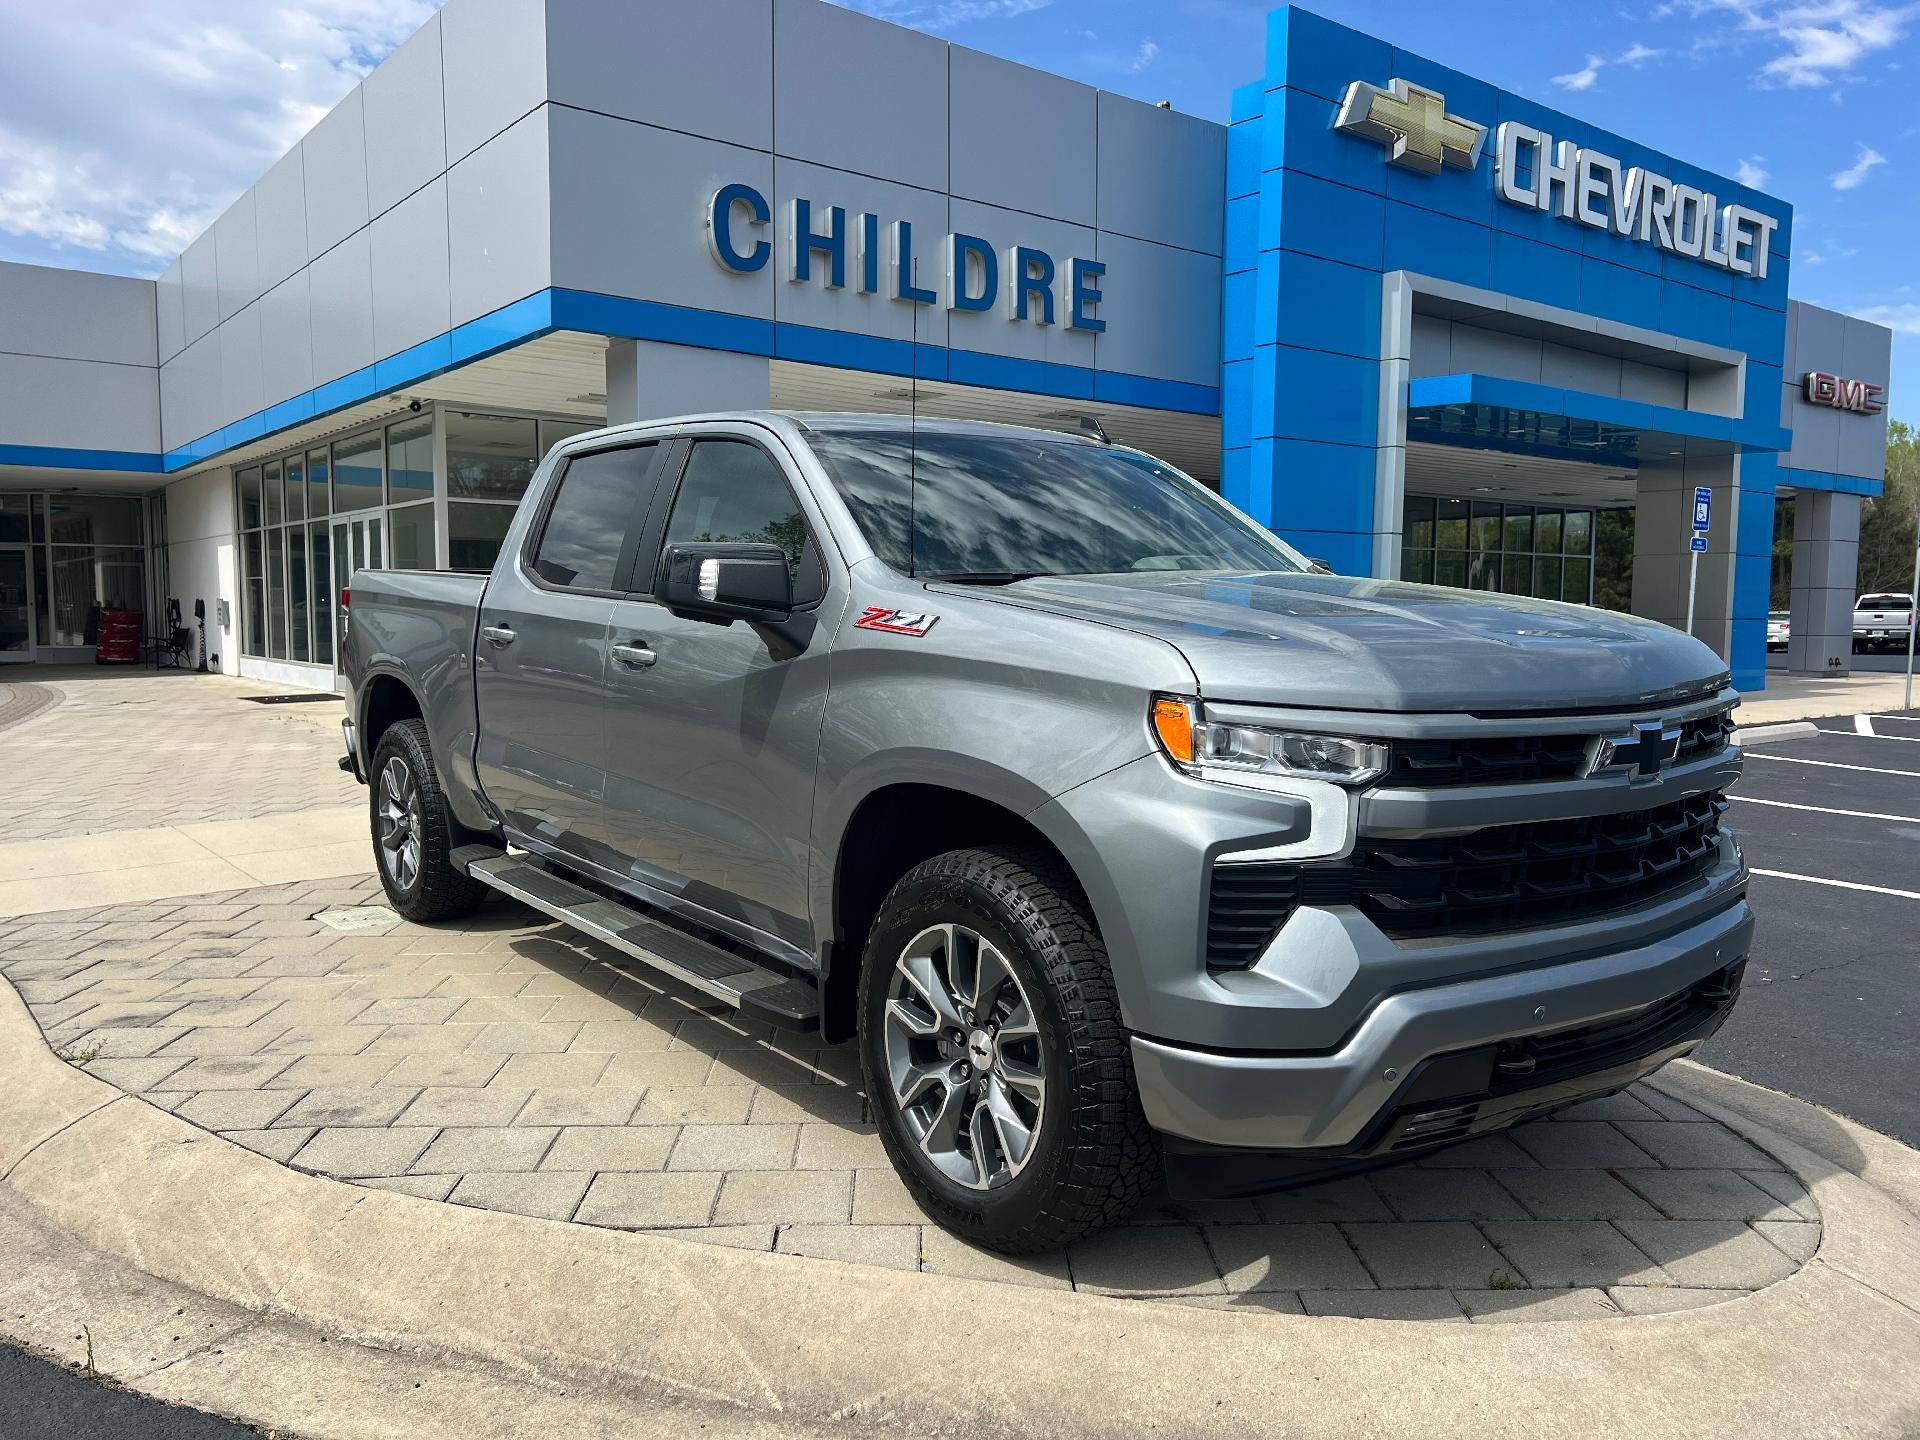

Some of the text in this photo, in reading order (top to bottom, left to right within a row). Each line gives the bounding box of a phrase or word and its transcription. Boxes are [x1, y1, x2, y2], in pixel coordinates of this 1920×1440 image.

[1495, 121, 1779, 279] CHEVROLET
[707, 183, 1107, 333] CHILDRE
[1804, 372, 1884, 416] GMC
[853, 606, 941, 638] Z71
